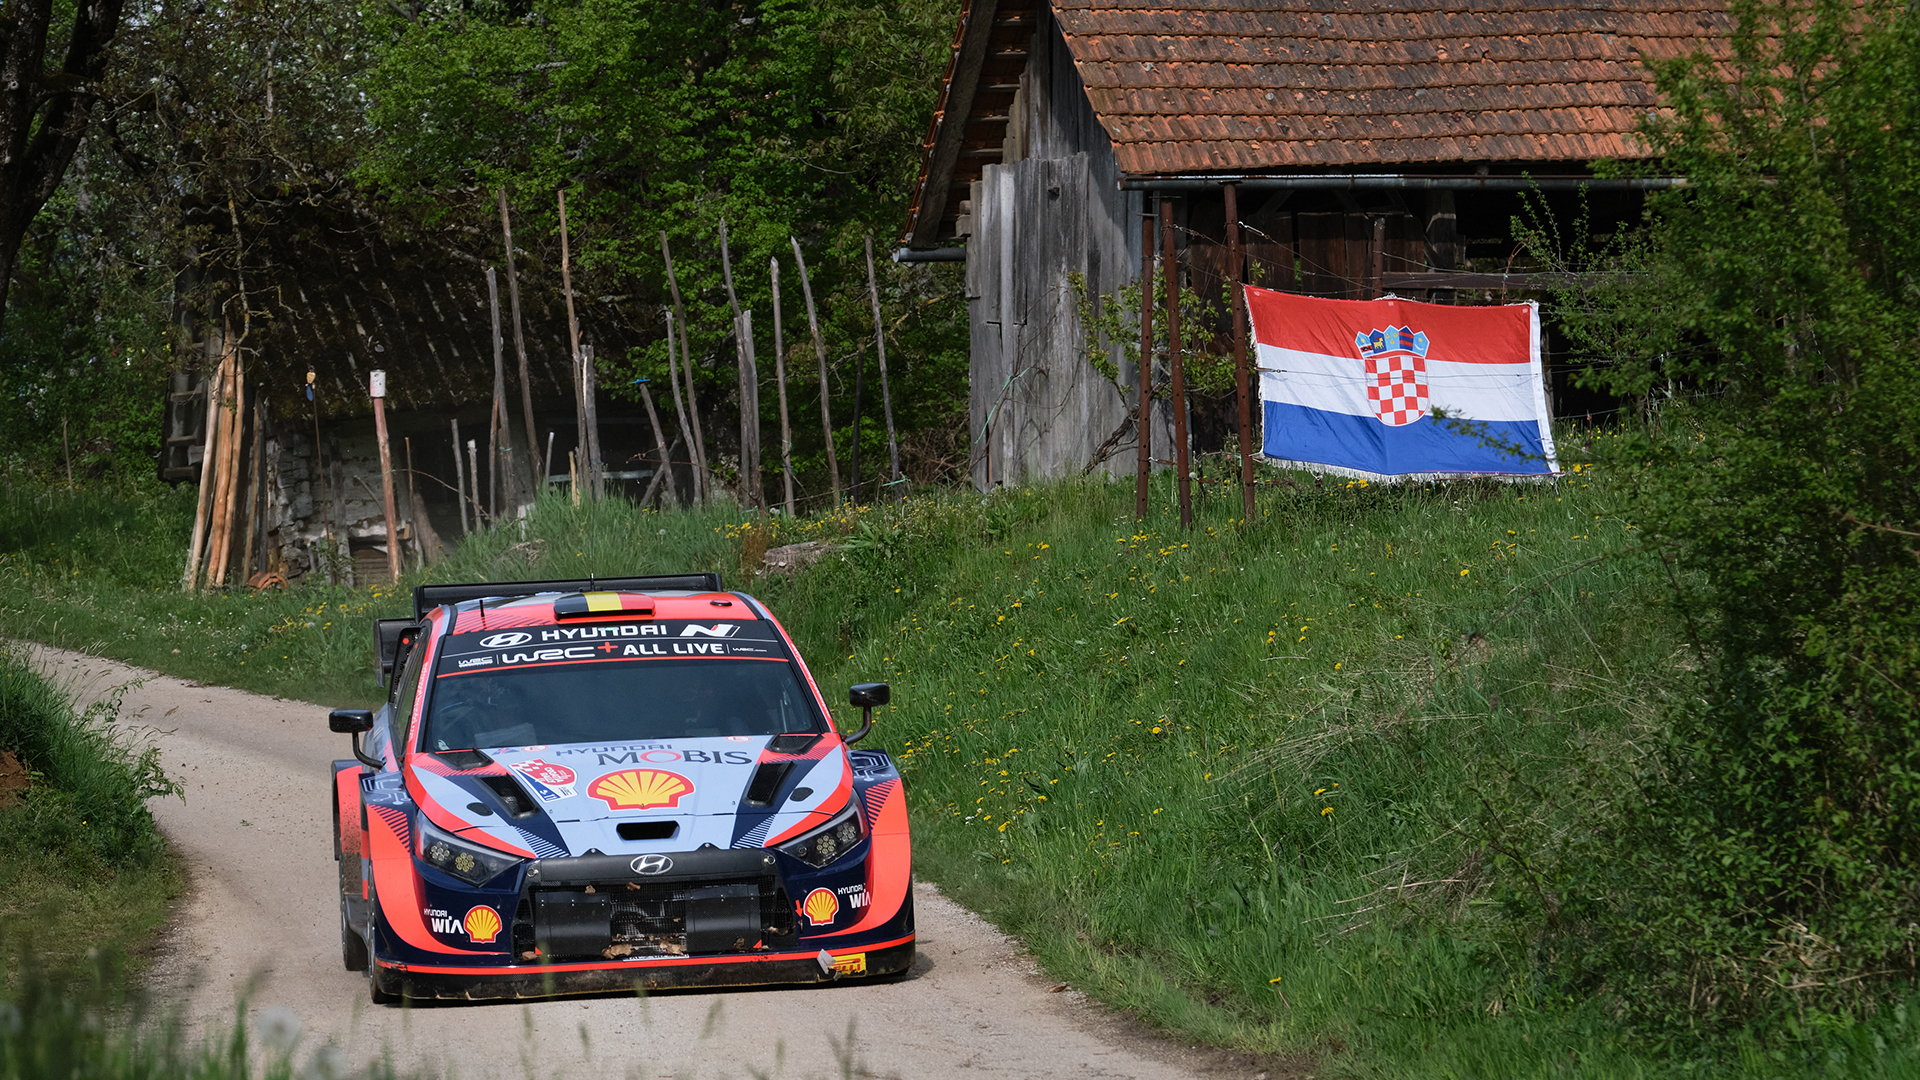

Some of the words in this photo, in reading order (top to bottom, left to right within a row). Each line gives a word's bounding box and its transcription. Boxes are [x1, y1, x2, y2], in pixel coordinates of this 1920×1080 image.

[541, 624, 667, 641] HYUNDAI
[679, 623, 741, 637] N
[623, 643, 667, 656] ALL
[672, 643, 724, 655] LIVE
[556, 744, 673, 757] HYUNDAI
[598, 749, 752, 766] MOBIS
[837, 884, 864, 895] HYUNDAI
[423, 908, 448, 918] HYUNDAI
